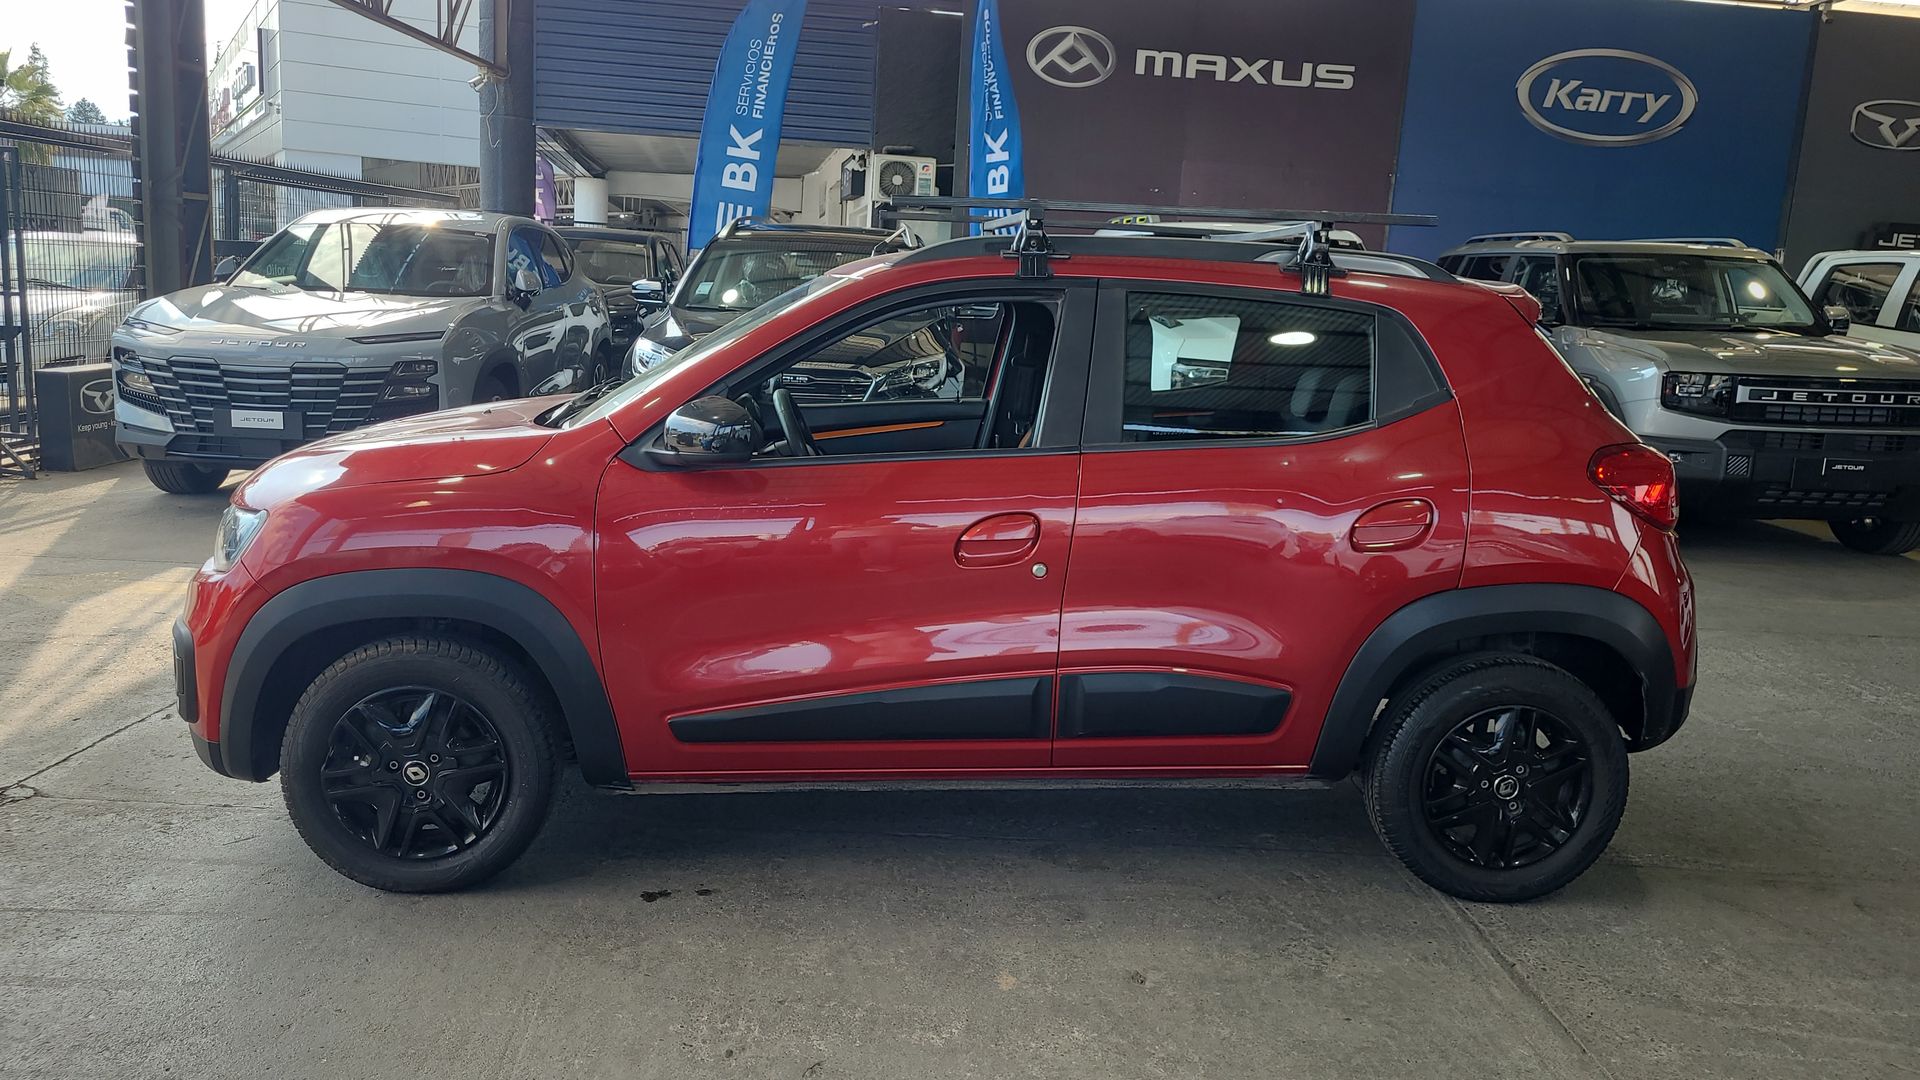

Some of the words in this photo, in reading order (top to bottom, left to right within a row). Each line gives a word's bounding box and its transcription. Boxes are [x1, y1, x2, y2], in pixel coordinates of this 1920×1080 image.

[735, 38, 763, 116] SERVICIOS
[752, 12, 784, 119] FINANCIEROS
[1134, 48, 1356, 90] MAXUS
[1542, 77, 1673, 124] Karry
[721, 123, 764, 192] BK
[984, 127, 1010, 195] BK
[1878, 232, 1920, 249] JE
[210, 338, 307, 348] JETOUR
[1760, 390, 1920, 405] JETOUR
[77, 423, 92, 432] Keep
[92, 420, 108, 431] young
